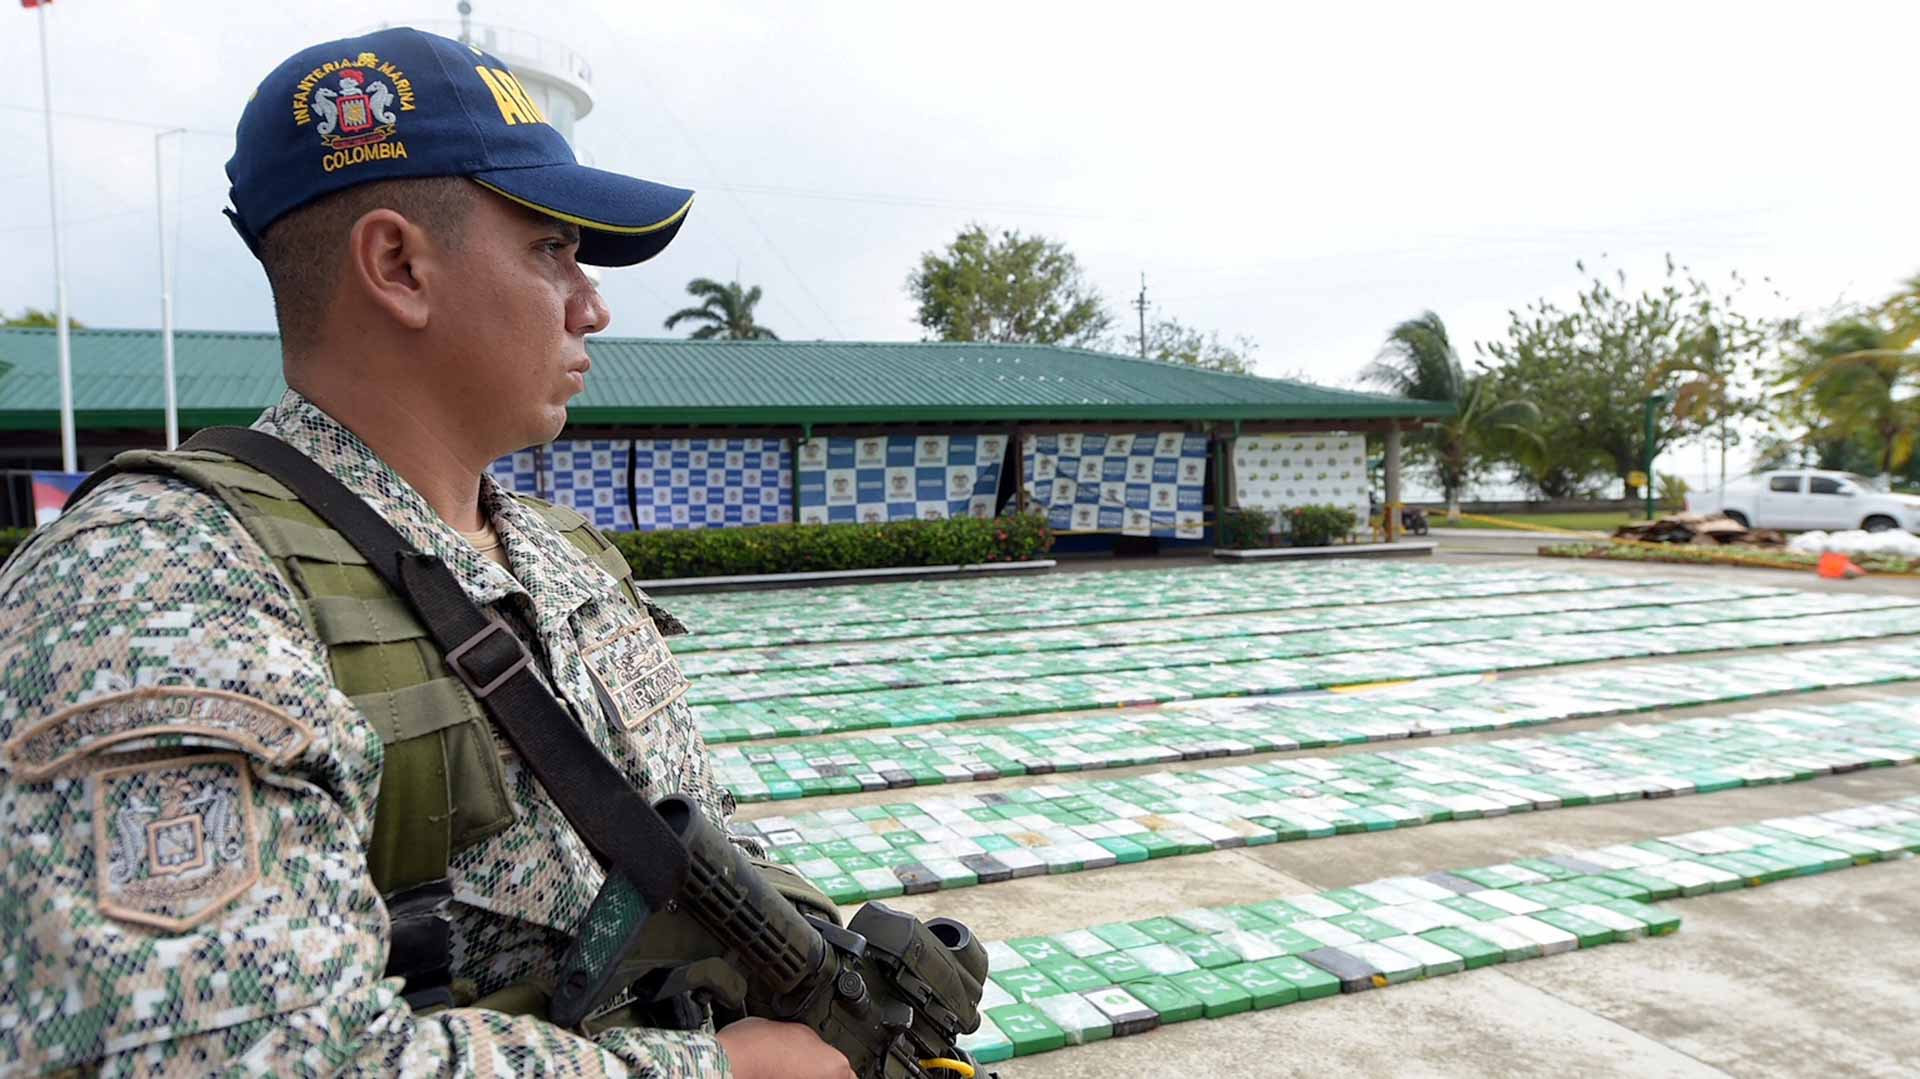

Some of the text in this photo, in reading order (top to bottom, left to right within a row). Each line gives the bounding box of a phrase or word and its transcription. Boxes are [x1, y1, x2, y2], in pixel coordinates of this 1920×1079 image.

[293, 58, 353, 126] INFANTERIA
[377, 61, 416, 112] MARINA
[475, 65, 546, 126] AR
[322, 141, 408, 172] COLOMBIA
[174, 698, 203, 717] DE
[211, 700, 296, 749] MARINA
